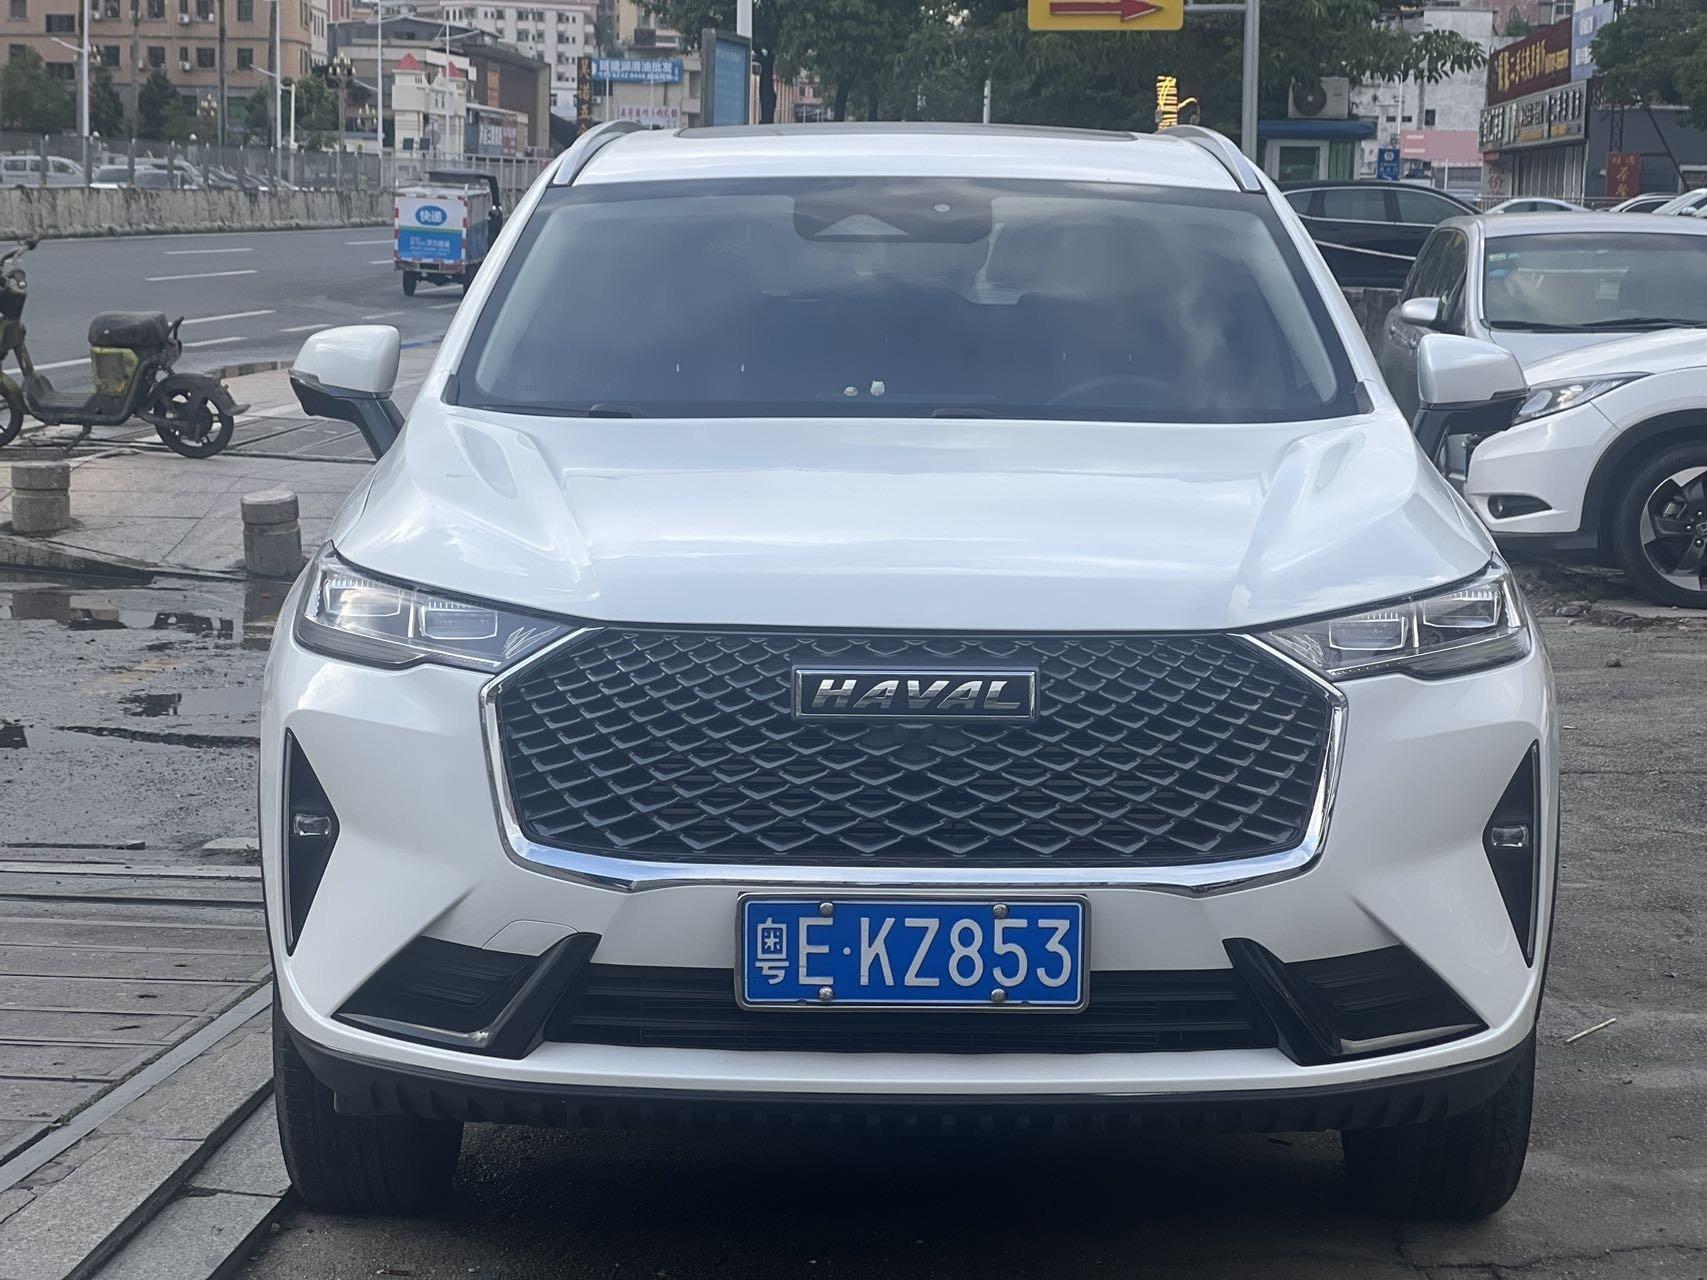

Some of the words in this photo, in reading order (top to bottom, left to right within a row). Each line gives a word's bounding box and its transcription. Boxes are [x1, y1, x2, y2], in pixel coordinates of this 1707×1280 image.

[419, 208, 443, 223] 快递
[811, 679, 1021, 710] HAVAL
[755, 917, 1073, 988] 粤E·KZ853
